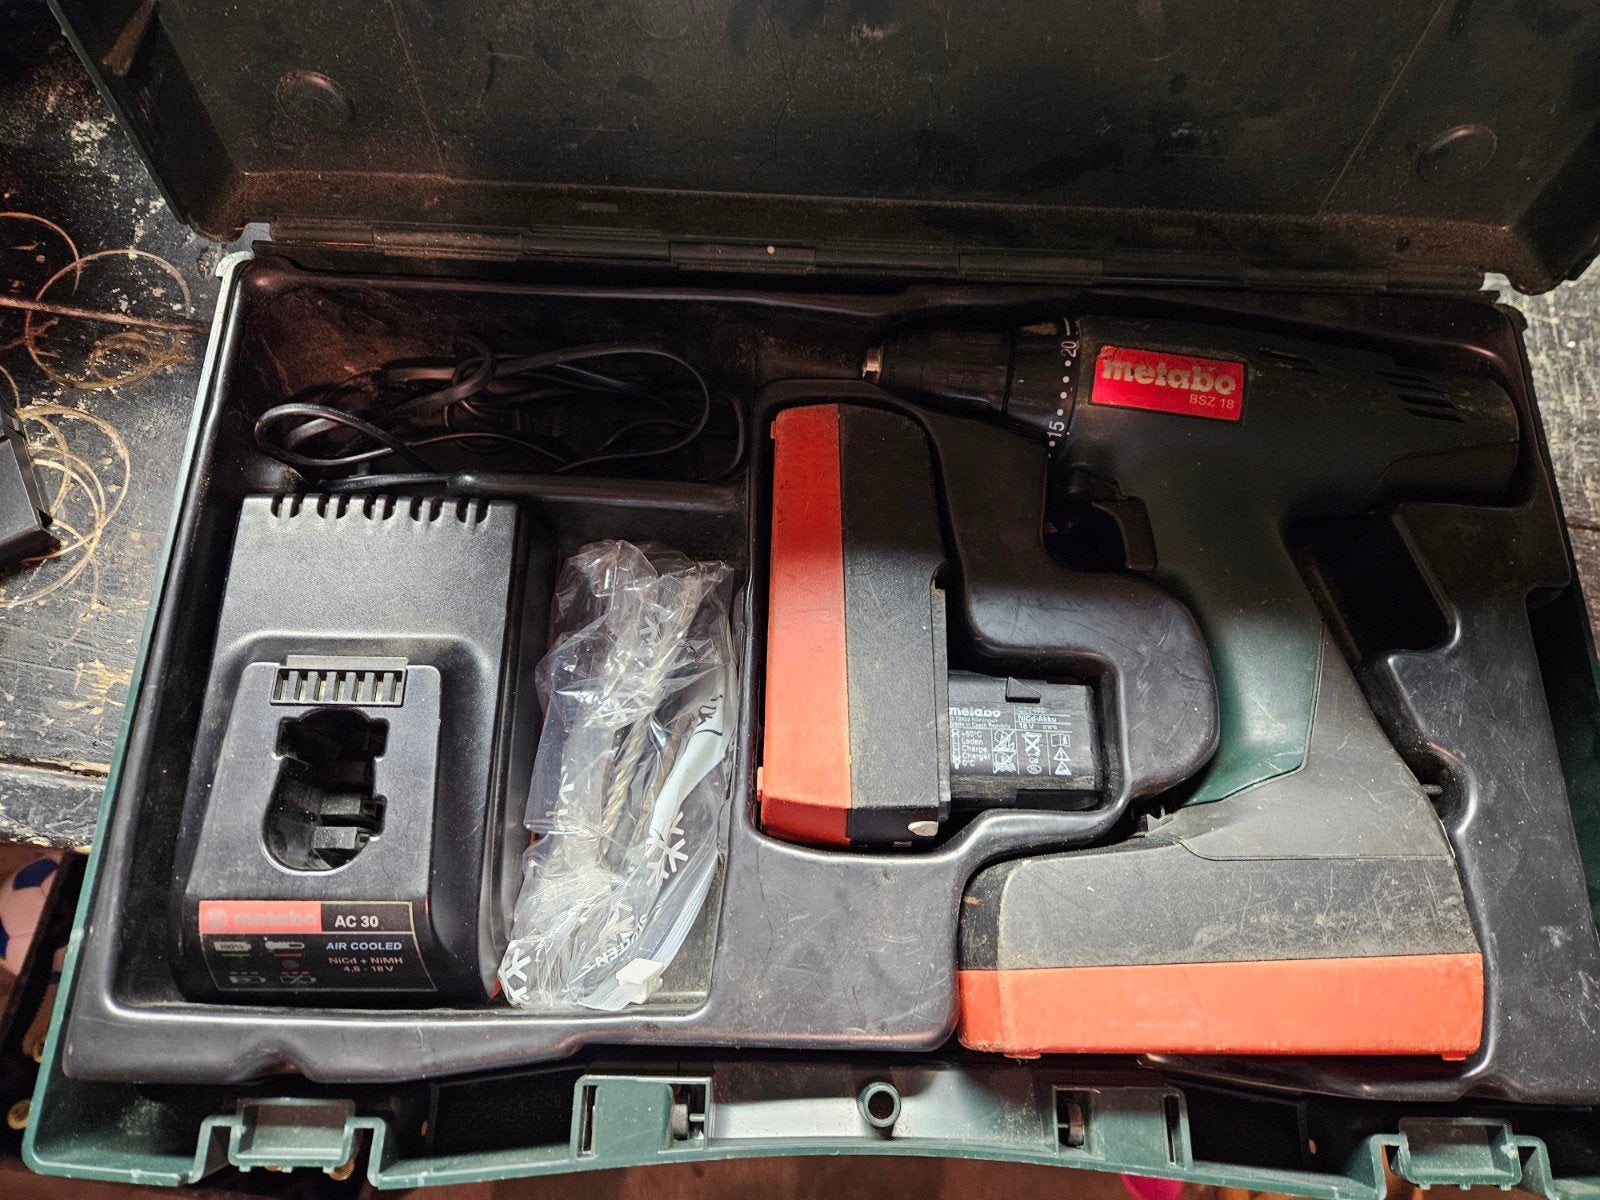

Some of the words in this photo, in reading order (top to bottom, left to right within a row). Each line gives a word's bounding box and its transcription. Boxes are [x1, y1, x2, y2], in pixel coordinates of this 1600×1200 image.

[1061, 340, 1077, 358] 20
[1102, 359, 1237, 395] metabo
[1189, 394, 1217, 408] BSZ
[1219, 397, 1235, 410] 18
[1047, 420, 1066, 439] 15
[334, 914, 357, 928] AC
[360, 915, 379, 928] 30
[326, 941, 347, 950] AIR
[350, 941, 403, 951] COOLED
[328, 956, 357, 965] NiCd
[369, 956, 404, 965] NiMH
